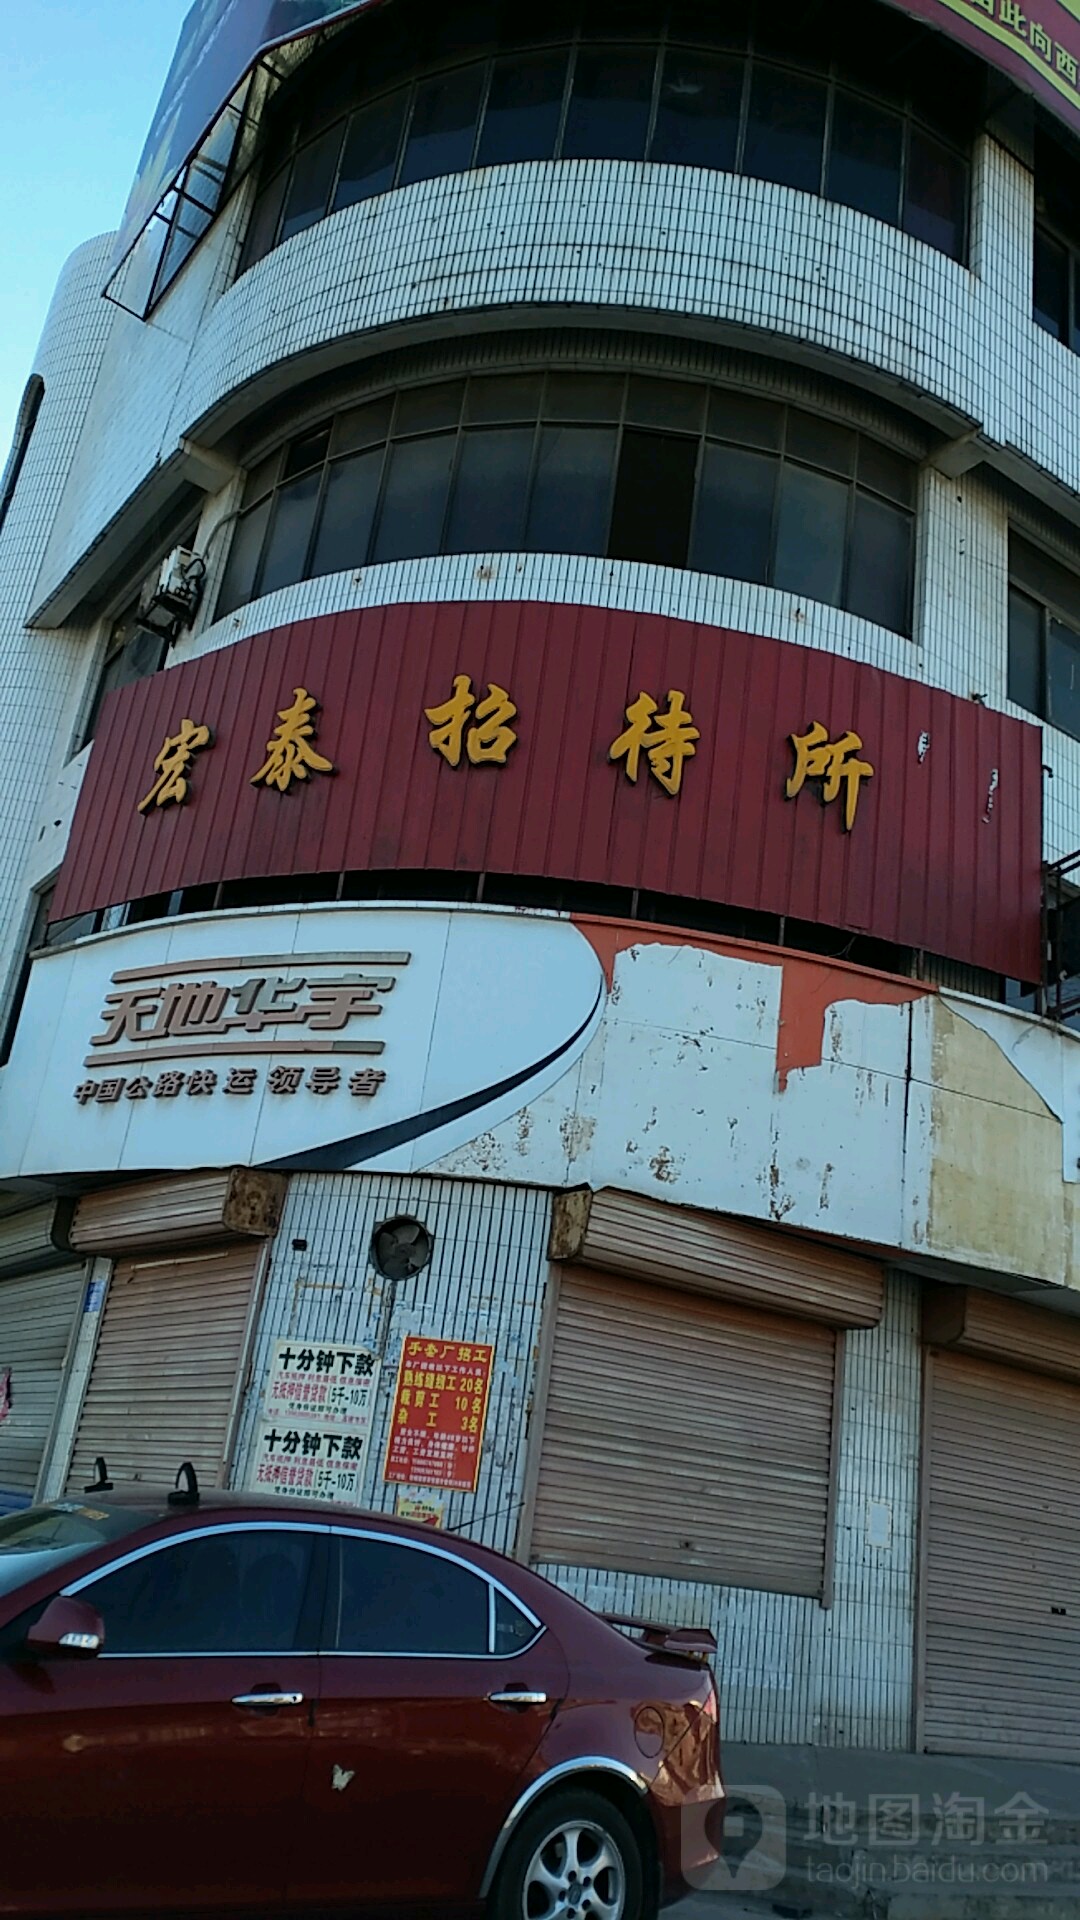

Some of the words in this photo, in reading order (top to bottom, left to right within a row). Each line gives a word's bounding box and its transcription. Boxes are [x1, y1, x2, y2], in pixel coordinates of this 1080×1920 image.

[137, 674, 875, 833] 宏泰招待所
[90, 973, 396, 1046] 天地华宇
[74, 1065, 386, 1105] 中国公路快运领导者
[279, 1347, 375, 1377] 十分钟下款
[264, 1428, 363, 1460] 十分钟下款
